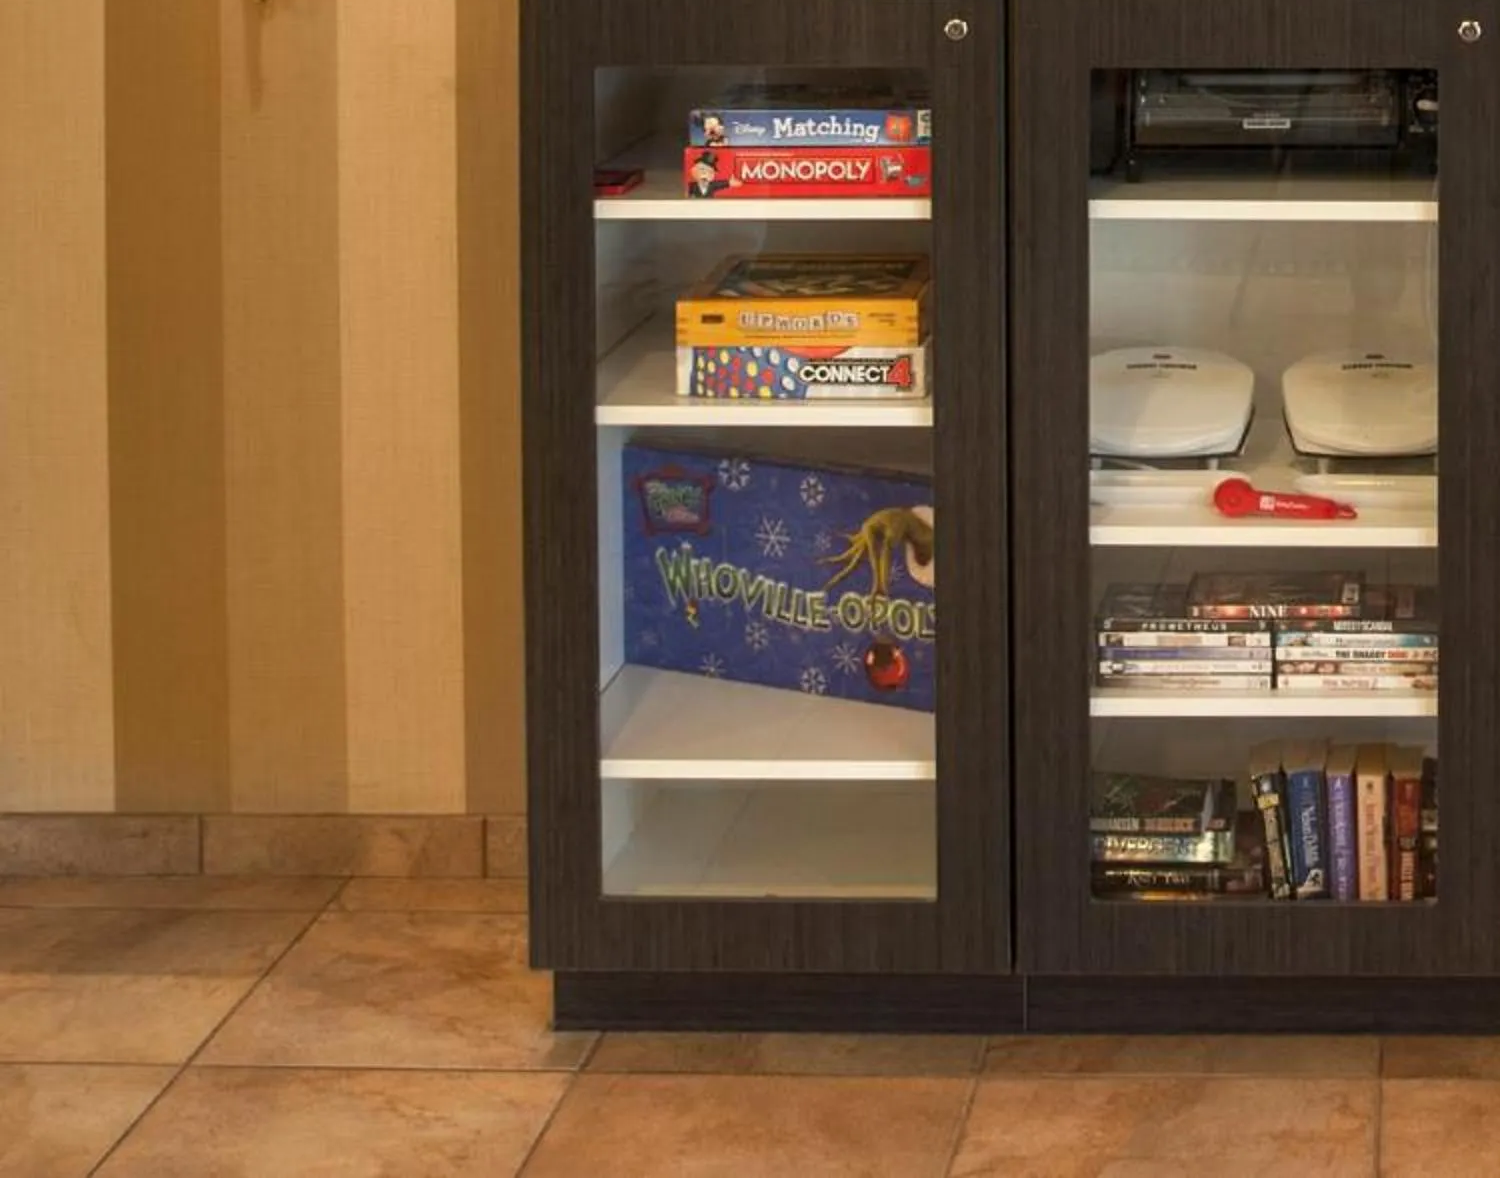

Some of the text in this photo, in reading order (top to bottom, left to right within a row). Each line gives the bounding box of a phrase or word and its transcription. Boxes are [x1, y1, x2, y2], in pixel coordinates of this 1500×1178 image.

[773, 116, 880, 142] Matching
[741, 160, 870, 181] MONOPOLY
[800, 357, 912, 389] CONNECT 4
[1249, 605, 1288, 619] NINE
